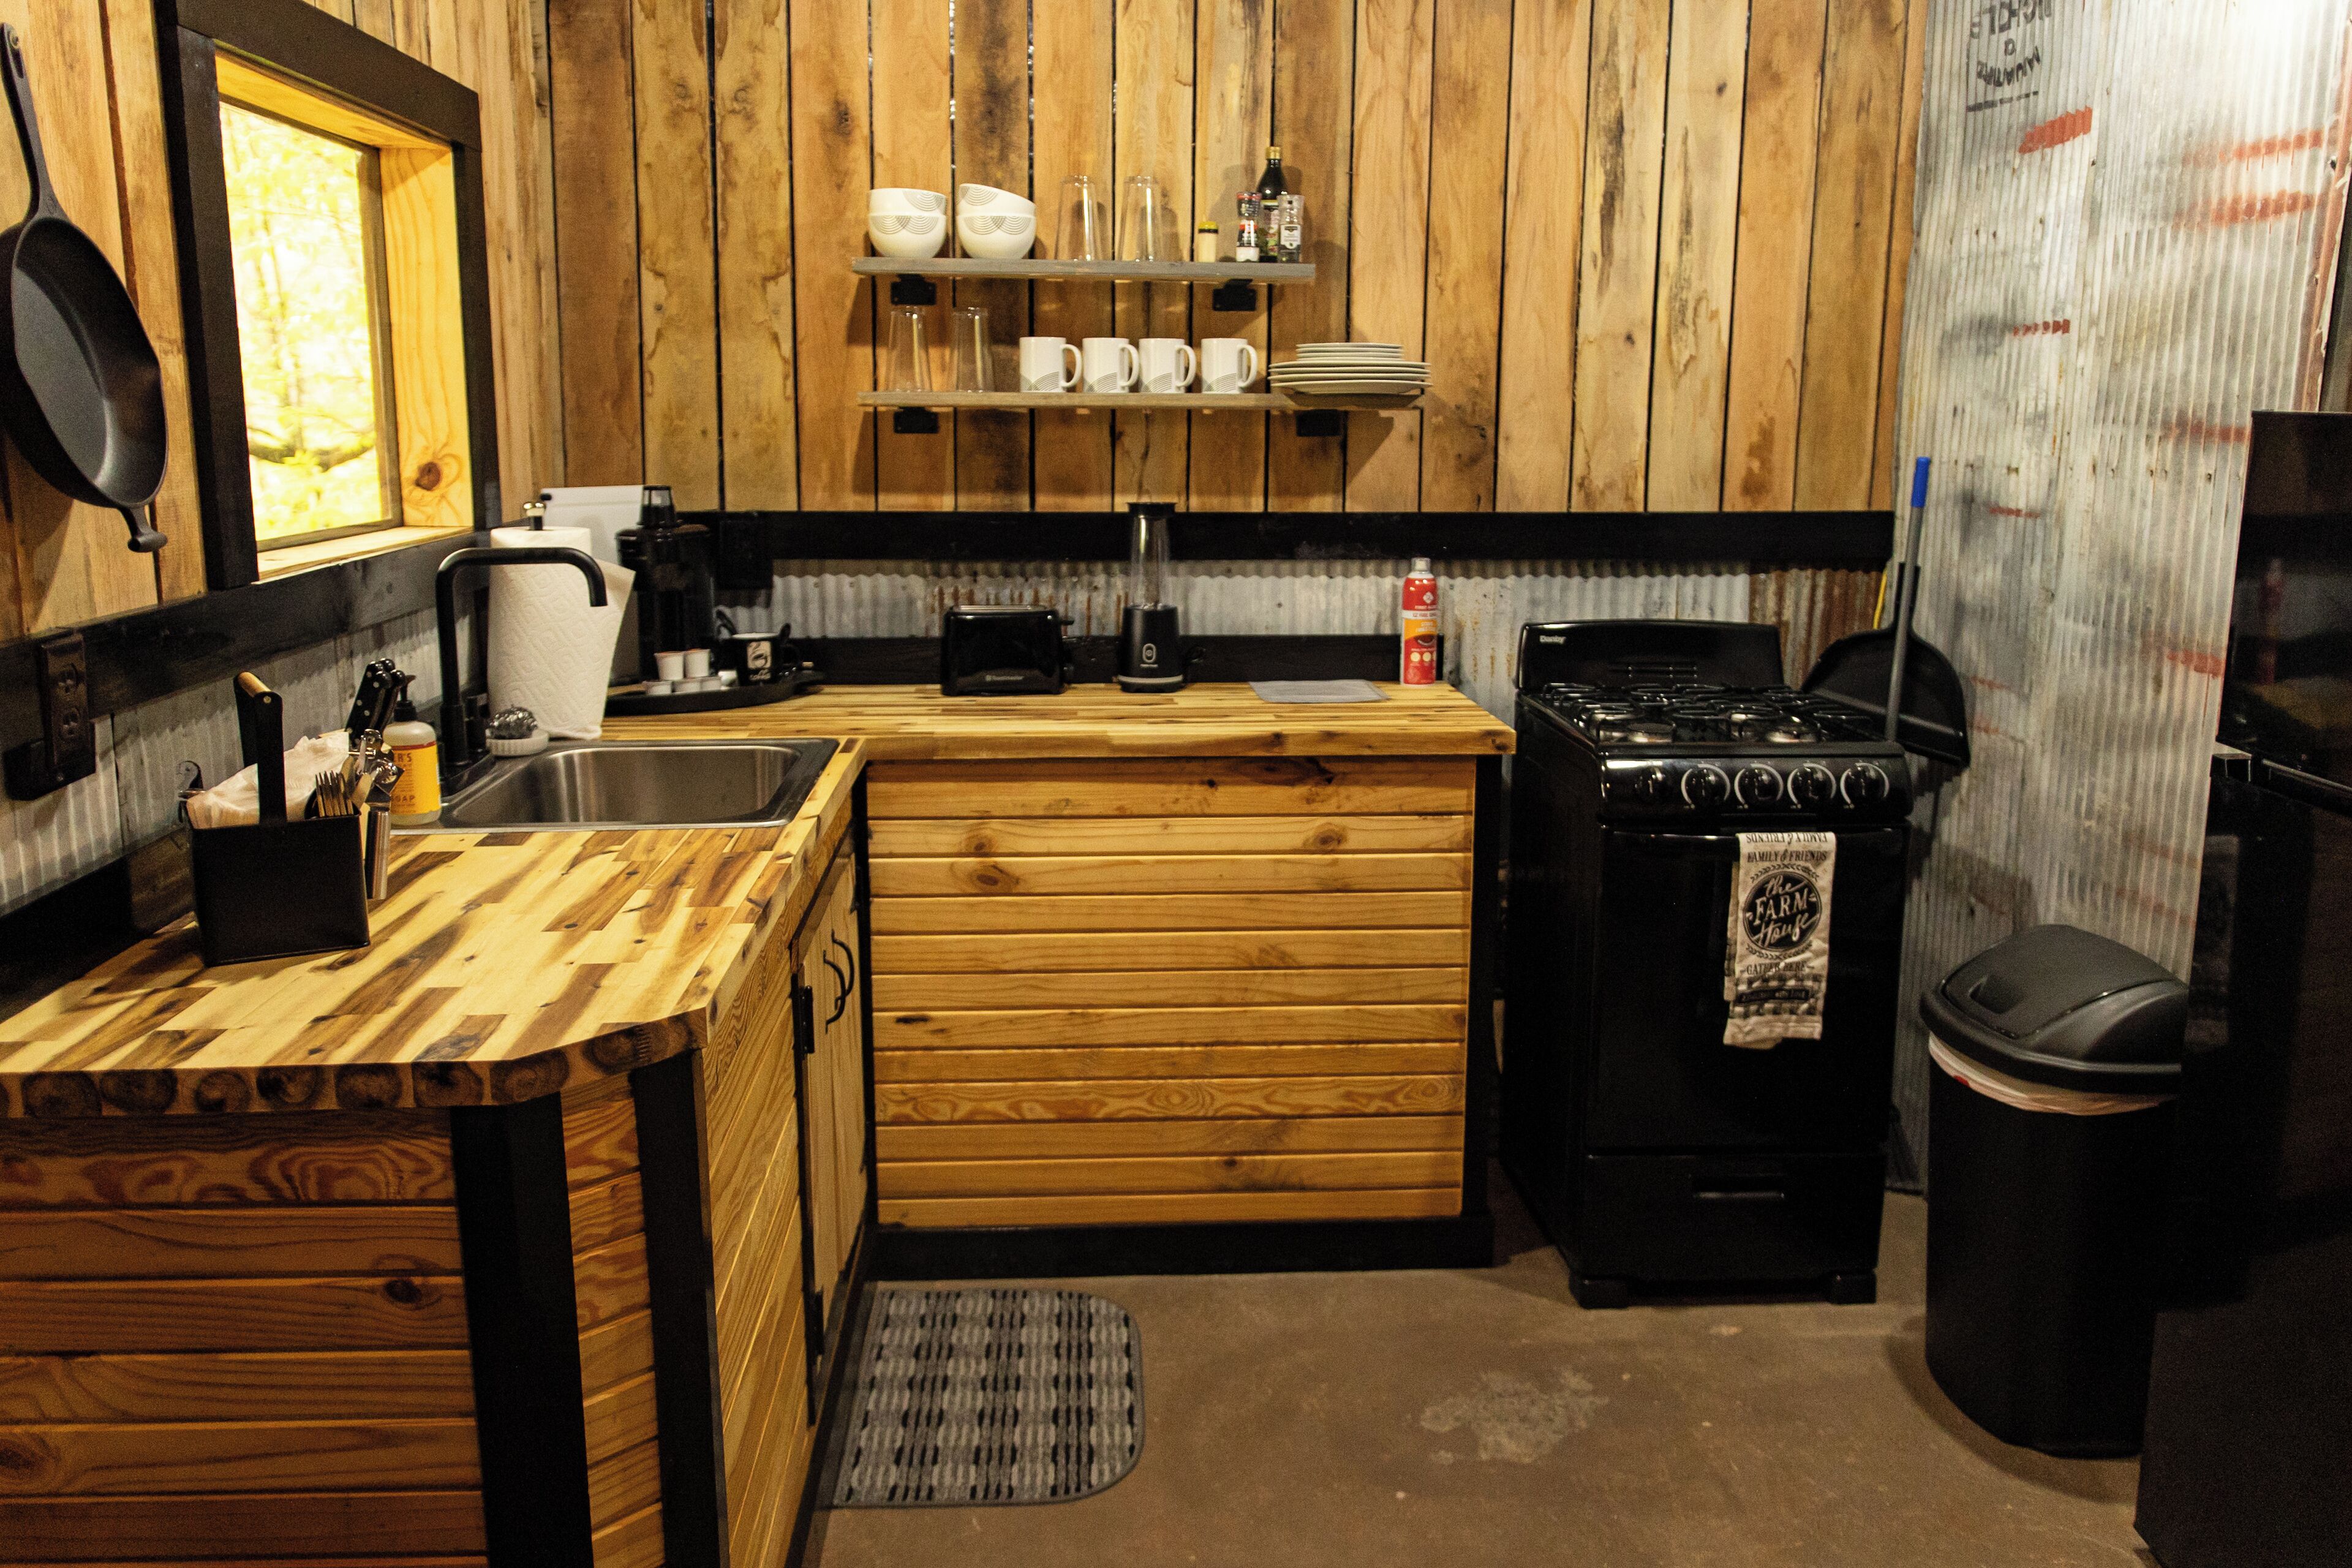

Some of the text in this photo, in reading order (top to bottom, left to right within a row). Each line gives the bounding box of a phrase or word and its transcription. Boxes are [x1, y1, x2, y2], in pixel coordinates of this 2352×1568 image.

[1746, 832, 1785, 843] FRIENDS
[1796, 832, 1828, 843] FAMILY
[1747, 850, 1779, 863] FAMILY
[1789, 850, 1828, 862] FRIENDS
[1753, 888, 1809, 925] FARM
[1752, 912, 1820, 948] House
